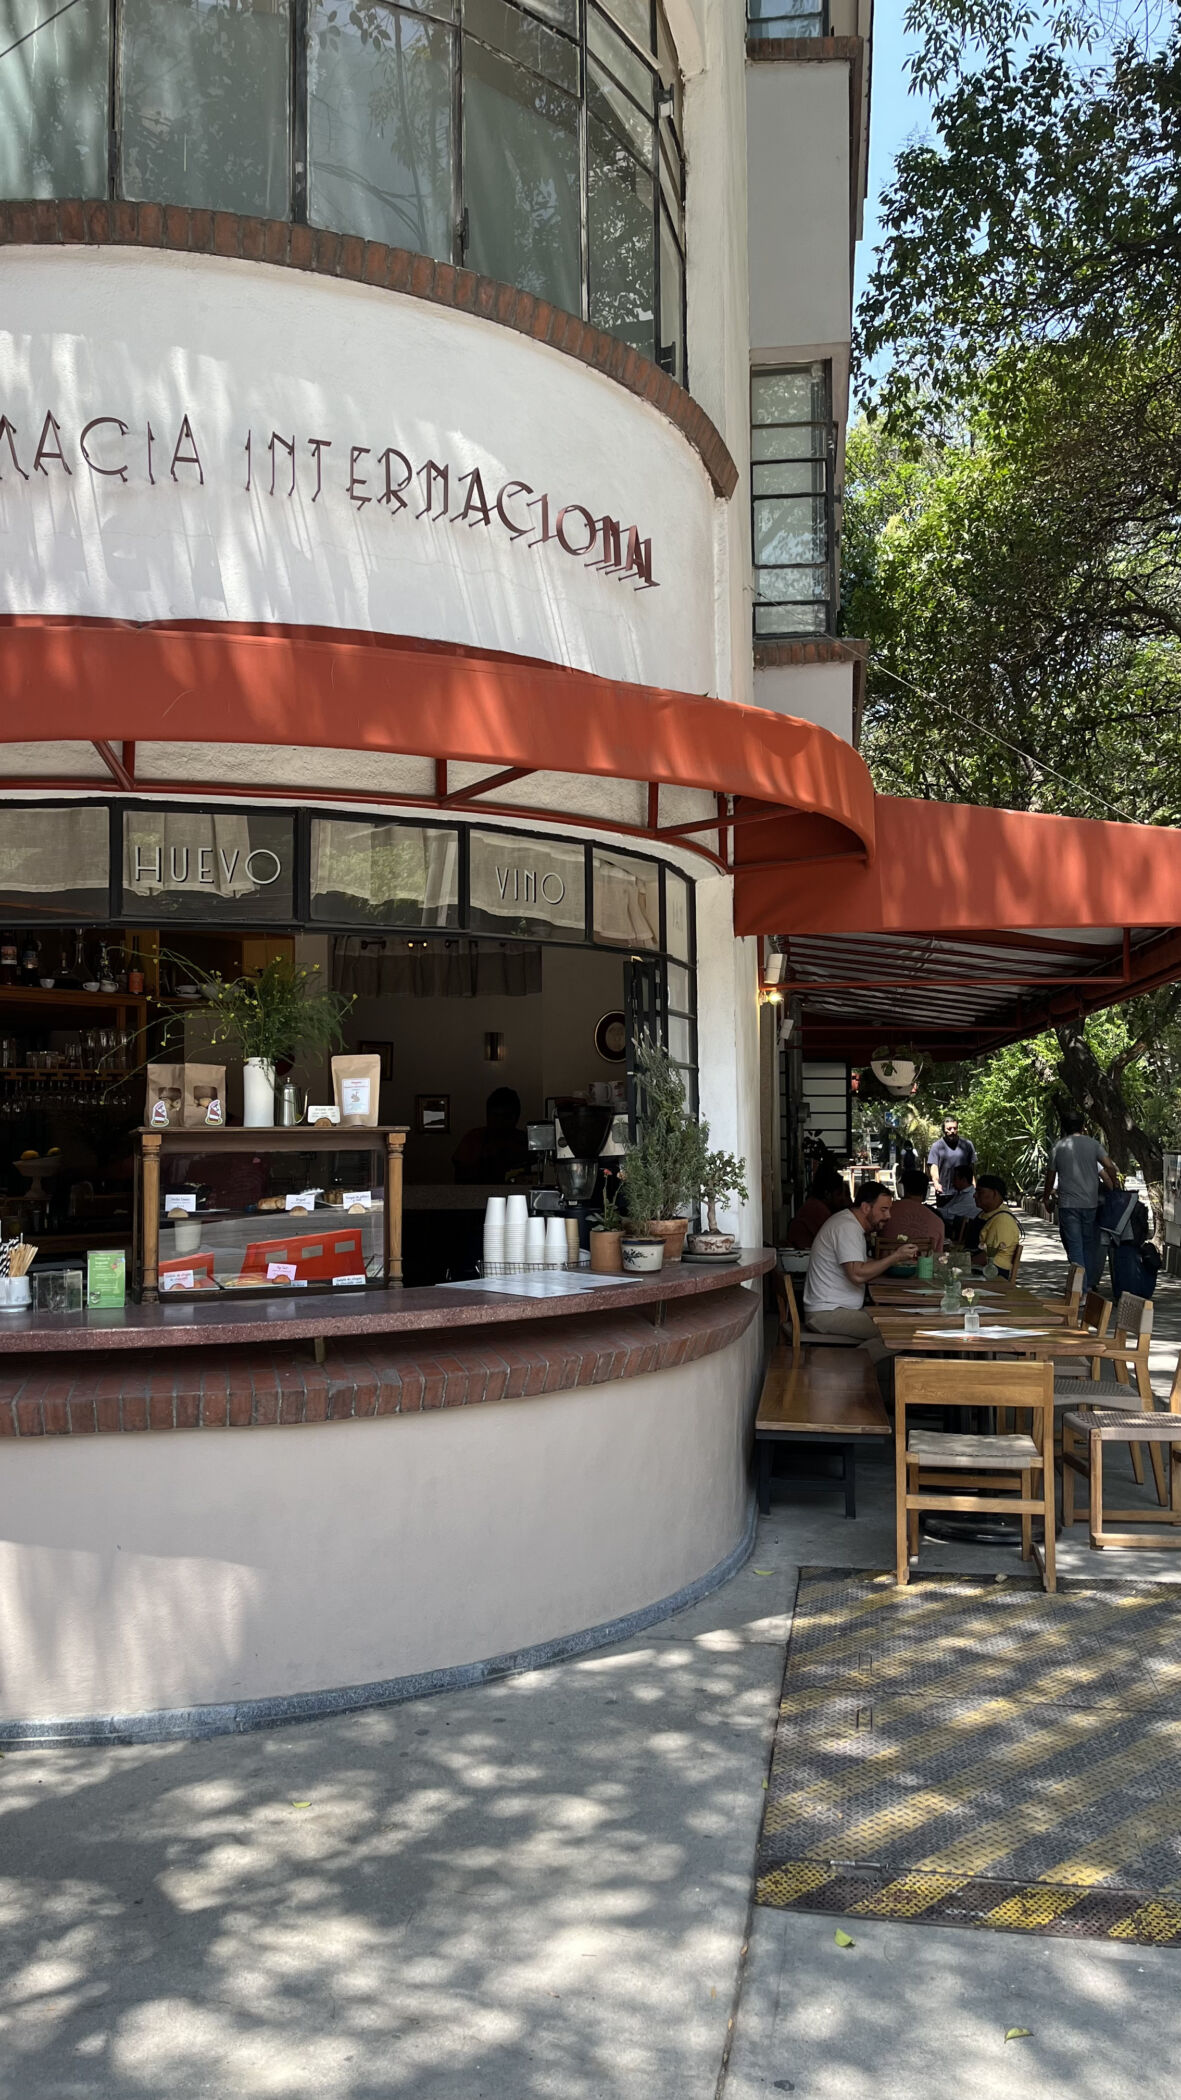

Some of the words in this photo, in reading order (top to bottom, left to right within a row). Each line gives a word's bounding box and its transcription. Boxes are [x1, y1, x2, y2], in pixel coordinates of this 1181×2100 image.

[244, 429, 661, 588] INTERNACIONAL
[134, 846, 281, 885] HUEVO
[495, 866, 565, 905] VINO
